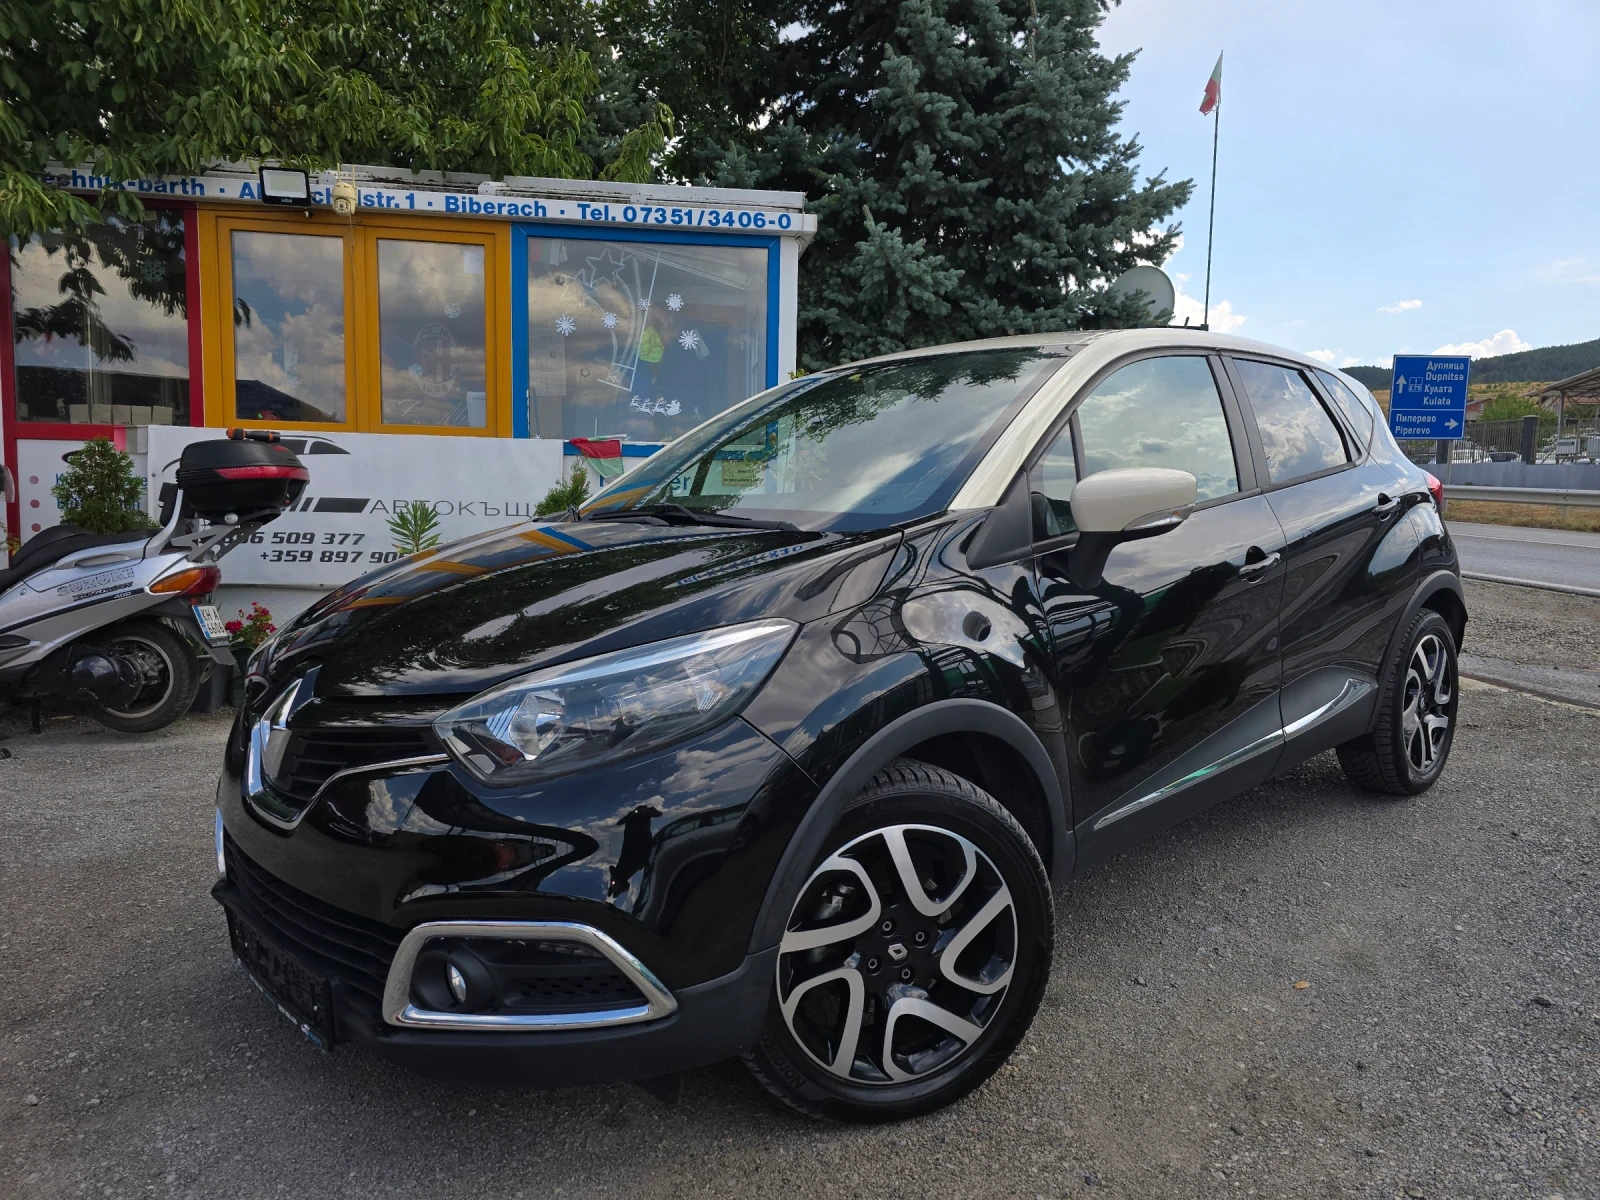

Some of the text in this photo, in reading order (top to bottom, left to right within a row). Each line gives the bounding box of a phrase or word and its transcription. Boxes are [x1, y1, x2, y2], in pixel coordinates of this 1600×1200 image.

[42, 170, 205, 196] echnik-barth
[445, 195, 547, 217] Biberach
[577, 203, 616, 222] Tel.
[622, 205, 792, 229] 07351/3406-0
[1426, 360, 1464, 371] Дупница
[1425, 372, 1464, 382] Dupnitsa
[1424, 384, 1452, 394] Кулата
[1423, 396, 1451, 405] Kulata
[1396, 413, 1436, 424] Пиперево
[1395, 426, 1430, 436] Piperevo
[369, 499, 538, 519] АВОКЪЩ
[271, 532, 315, 545] 509
[321, 533, 365, 545] 377
[260, 550, 314, 562] +359
[319, 550, 363, 563] 897
[57, 567, 135, 597] SUZUKI
[113, 591, 132, 599] 400
